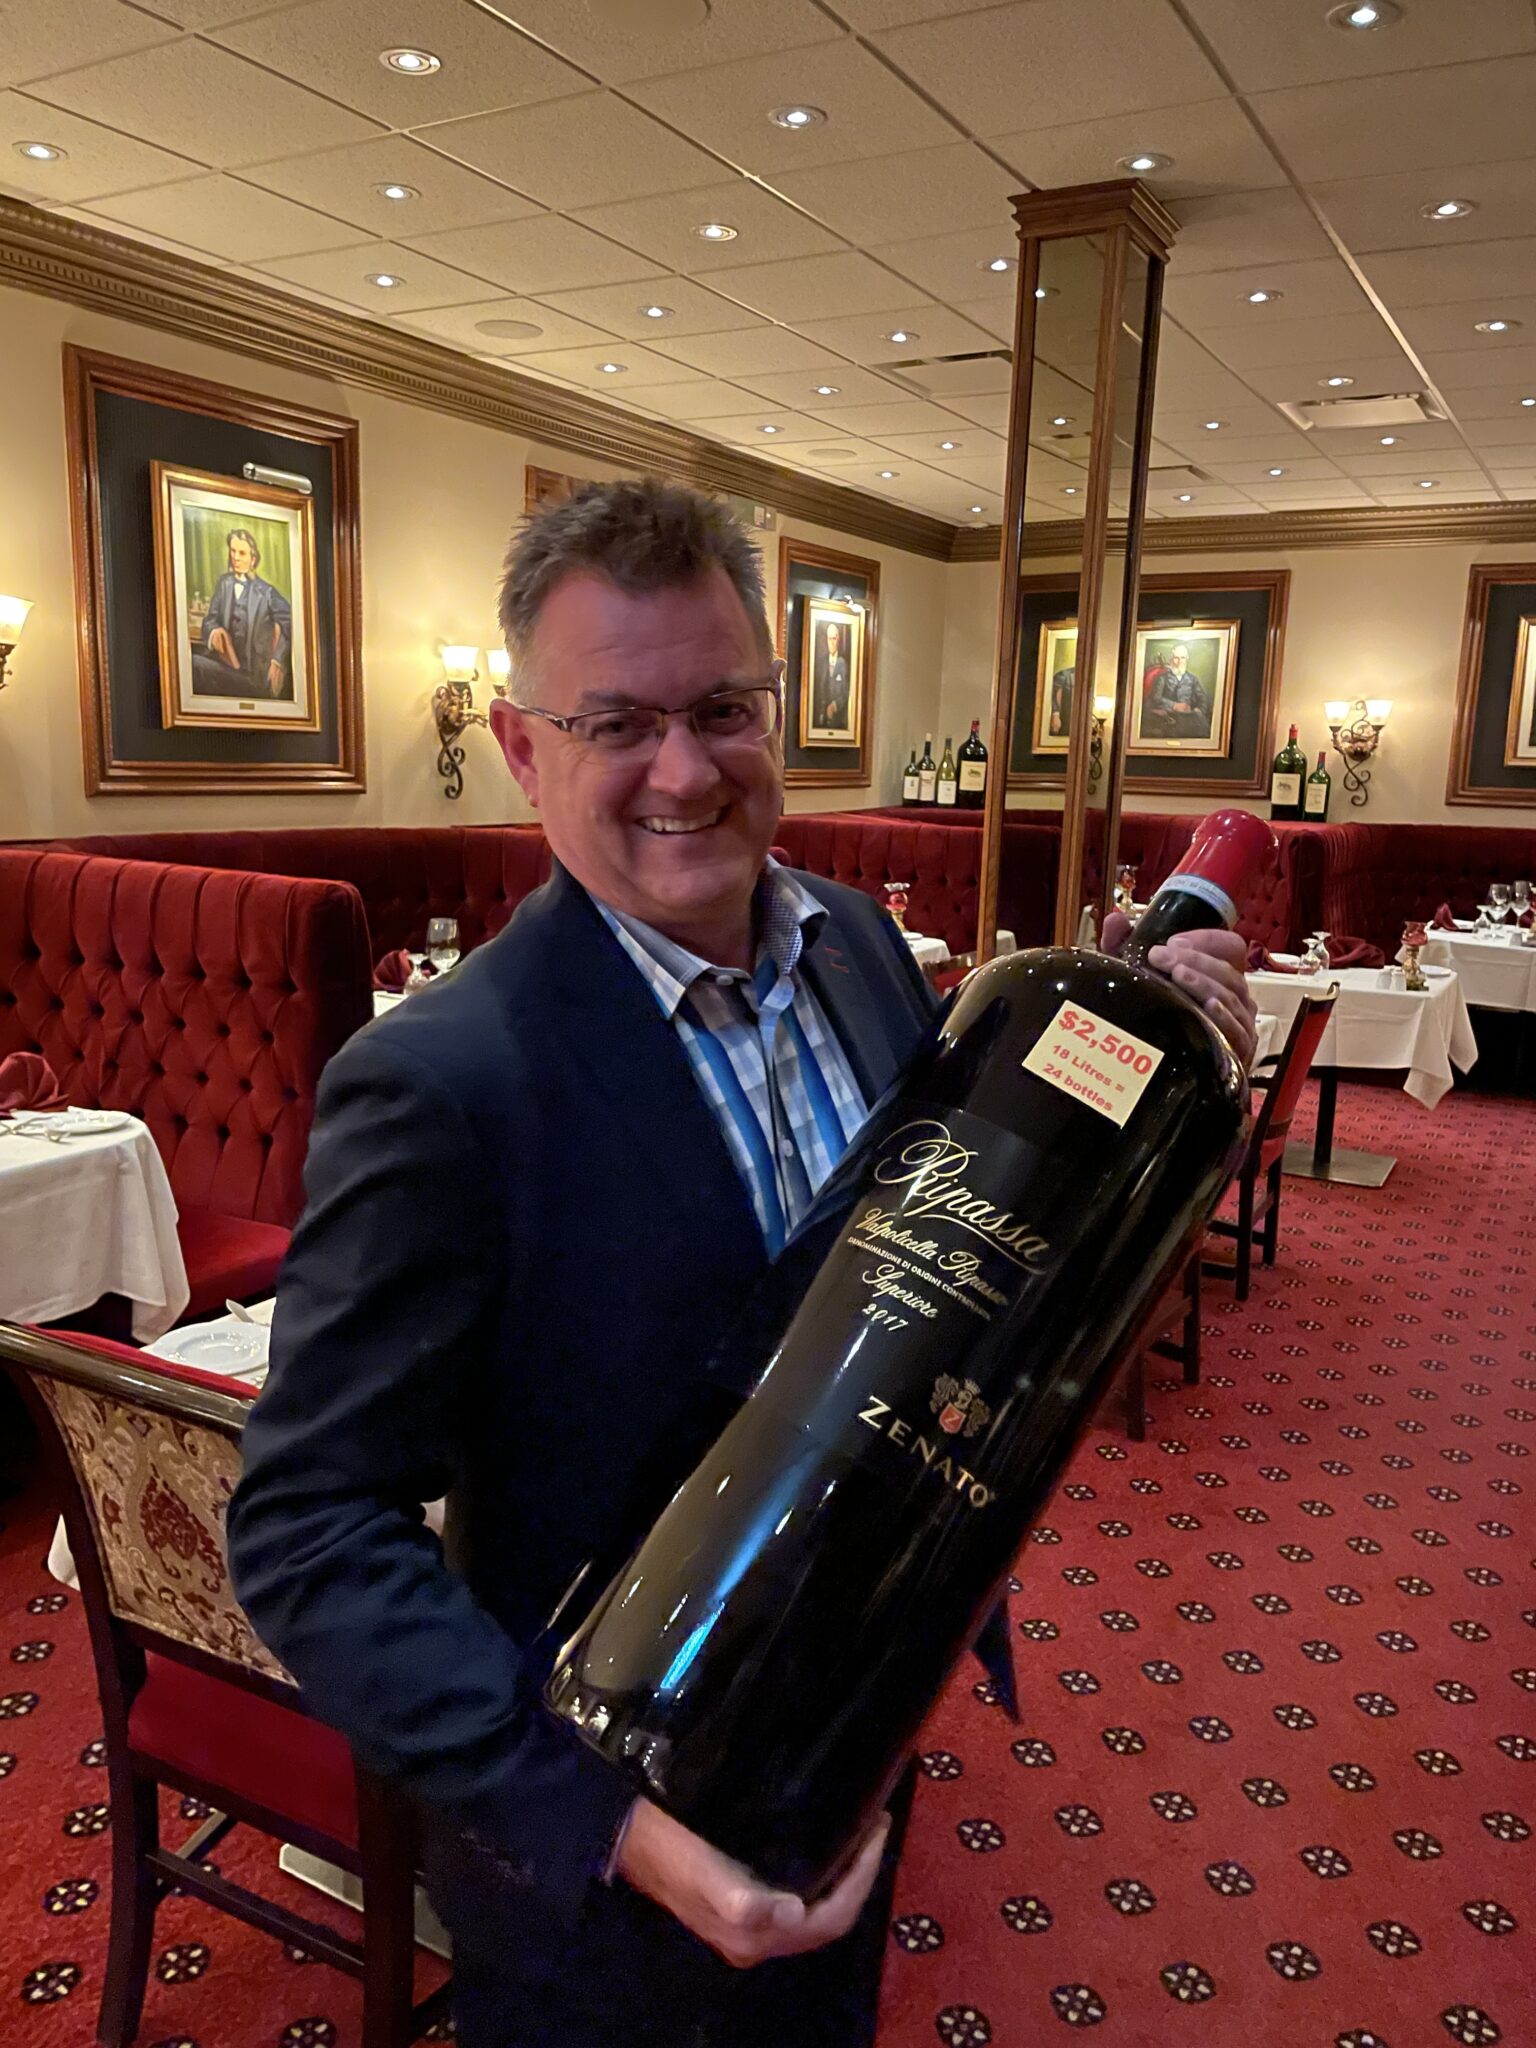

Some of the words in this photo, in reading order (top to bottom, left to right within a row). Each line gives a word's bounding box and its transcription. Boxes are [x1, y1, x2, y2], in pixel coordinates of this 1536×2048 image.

[1053, 1045, 1070, 1059] 18
[1071, 1055, 1112, 1086] Litres
[1058, 1010, 1153, 1075] $2,500
[1043, 1063, 1061, 1079] 24
[1064, 1075, 1113, 1111] bottles
[874, 1119, 1050, 1264] Ripassa
[856, 1208, 939, 1260] Valpolicella
[847, 1236, 902, 1264] DENOMINAZIONE
[901, 1260, 912, 1270] DI
[911, 1265, 942, 1287] ORIGINE
[862, 1264, 939, 1319] Superiore
[862, 1303, 908, 1331] 2017
[858, 1394, 989, 1508] ZENATO
